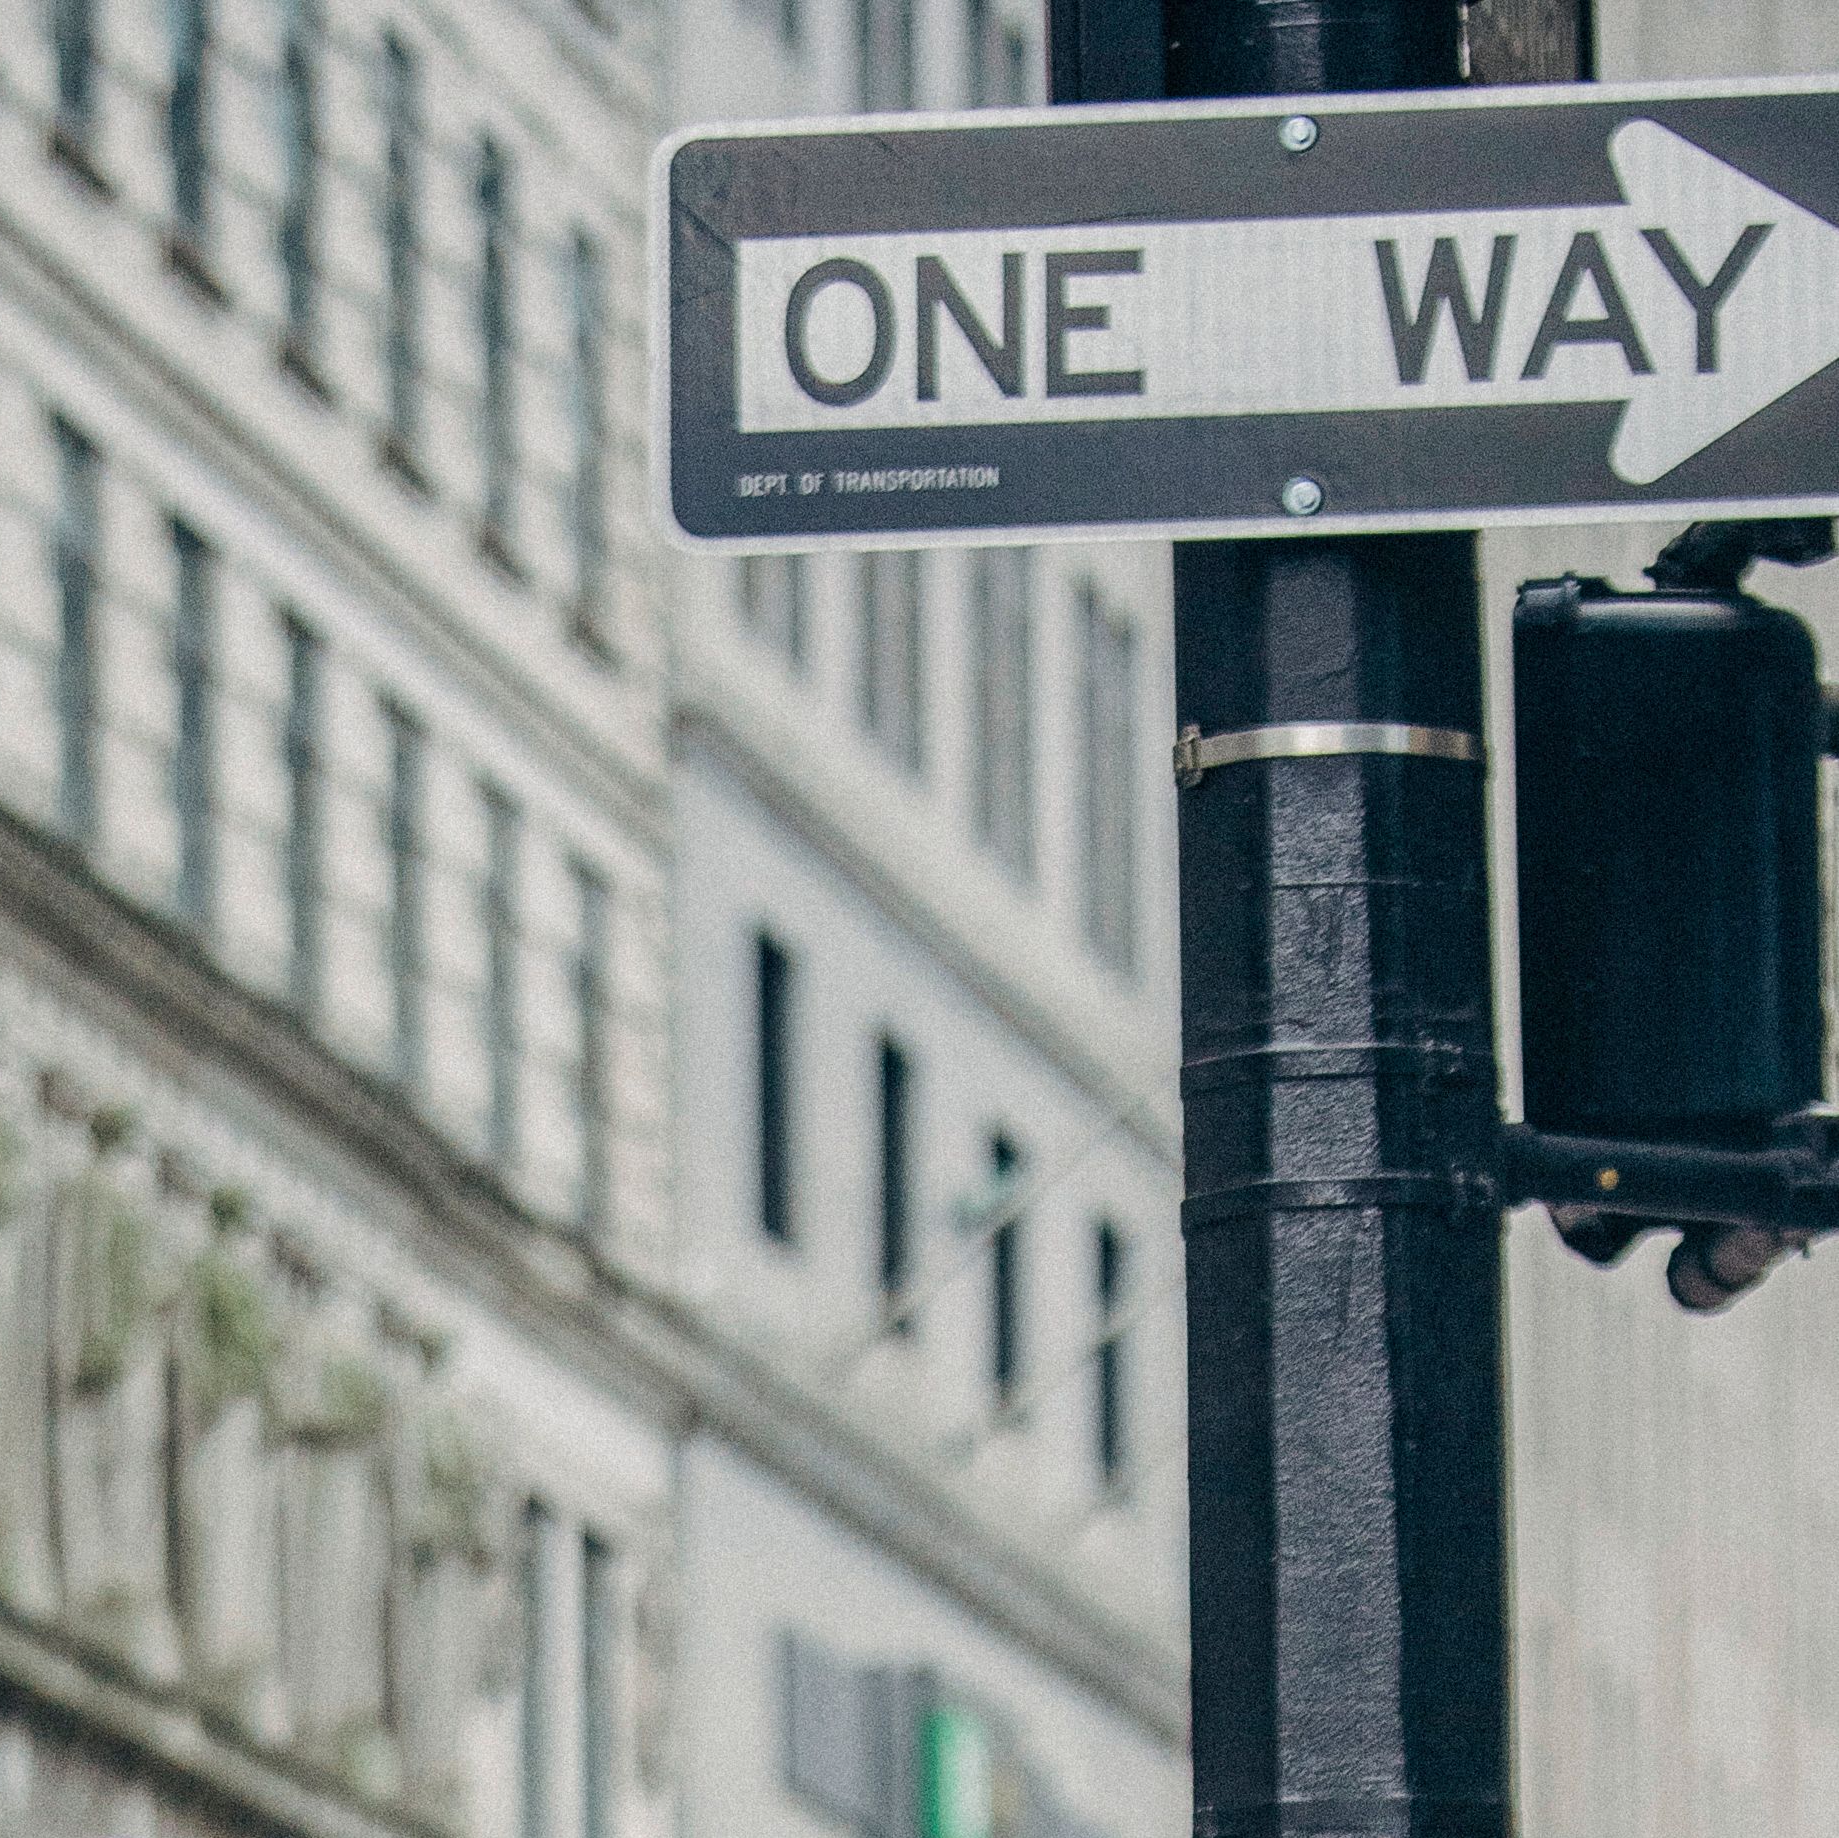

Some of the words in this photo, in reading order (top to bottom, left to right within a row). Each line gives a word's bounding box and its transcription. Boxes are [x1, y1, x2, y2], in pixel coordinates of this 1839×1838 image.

[784, 248, 1146, 408] ONE
[1374, 213, 1778, 386] WAY
[739, 473, 787, 497] DEPT
[800, 472, 824, 495] OF
[833, 466, 999, 493] TRANSPORTATION
